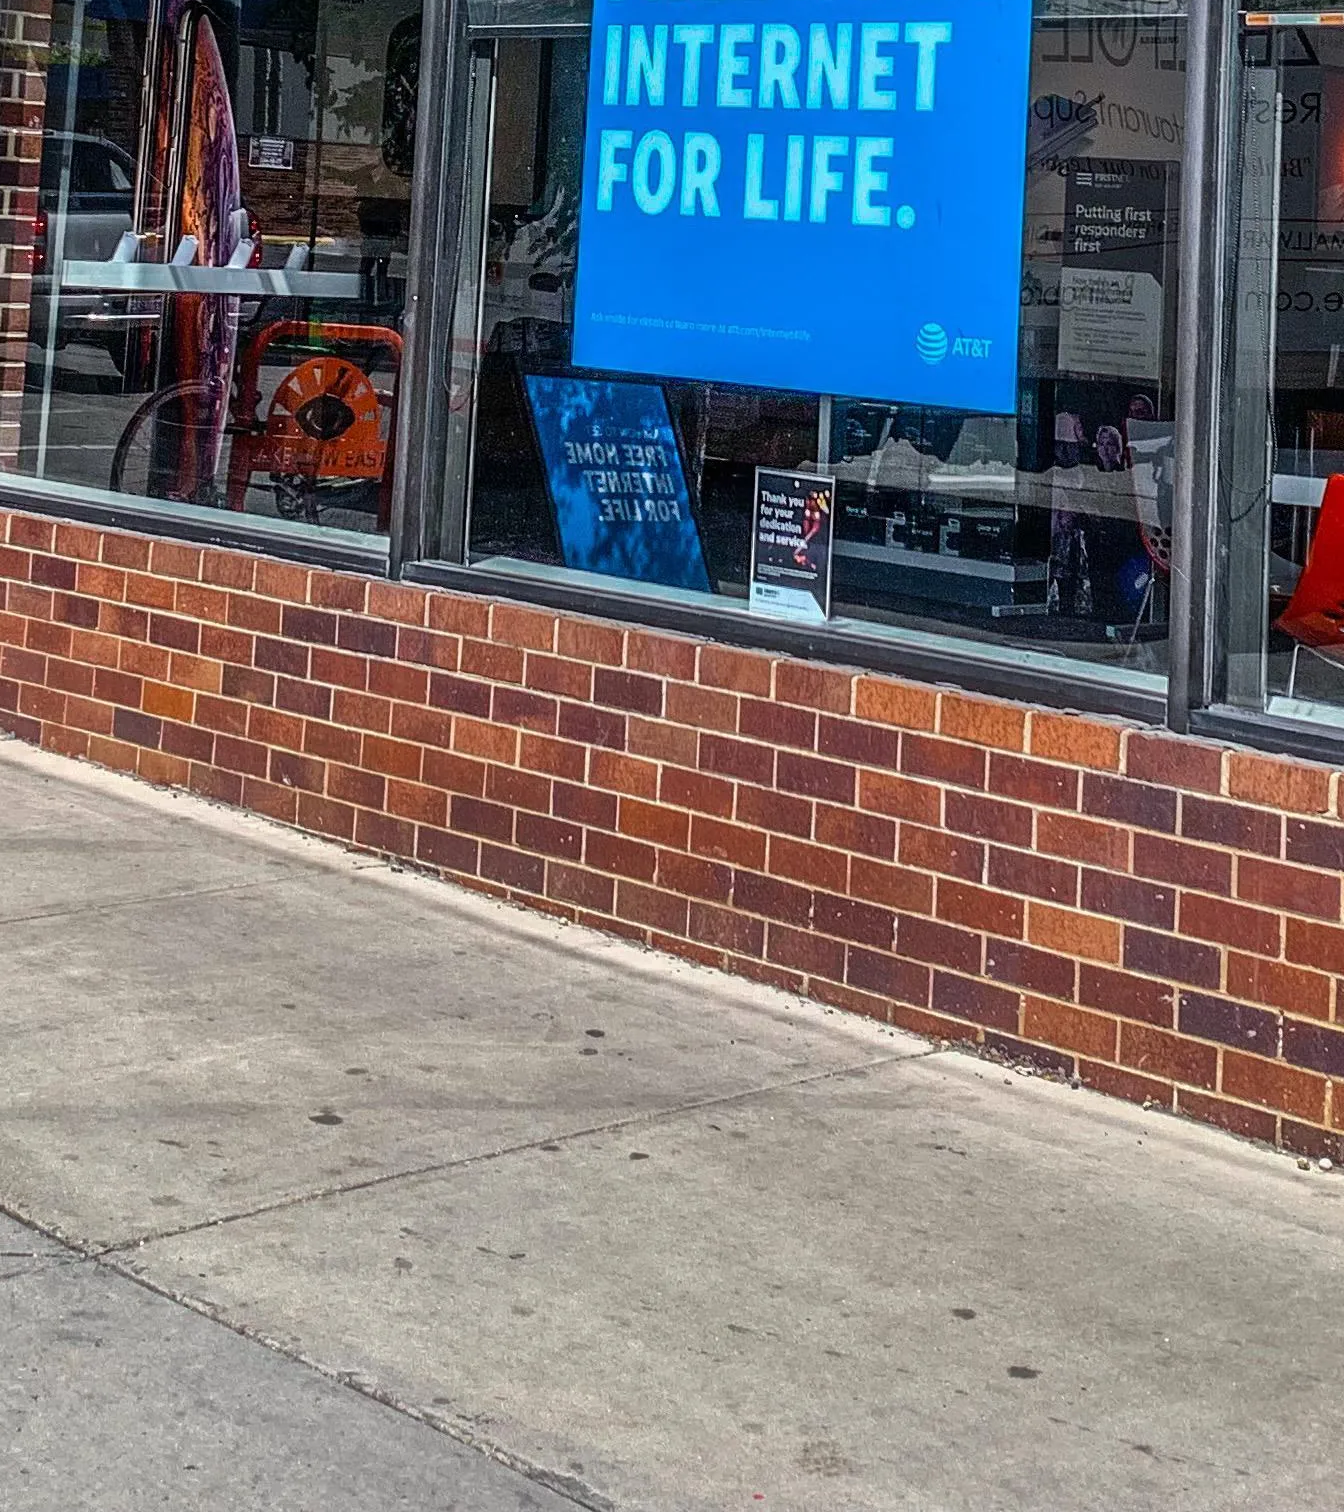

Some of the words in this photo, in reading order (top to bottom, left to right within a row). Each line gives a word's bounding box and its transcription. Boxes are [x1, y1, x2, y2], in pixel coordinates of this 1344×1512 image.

[602, 20, 953, 113] INTERNET
[595, 129, 722, 218] FOR
[743, 134, 917, 230] LIFE.
[1075, 204, 1122, 222] Putting
[1124, 206, 1152, 222] first
[1074, 224, 1146, 240] responders
[1074, 239, 1101, 253] first
[952, 334, 993, 359] AT&T
[761, 490, 787, 505] Thank
[788, 495, 805, 508] you
[760, 504, 773, 516] for
[774, 507, 794, 519] your
[759, 517, 802, 535] dedication
[758, 531, 775, 544] and
